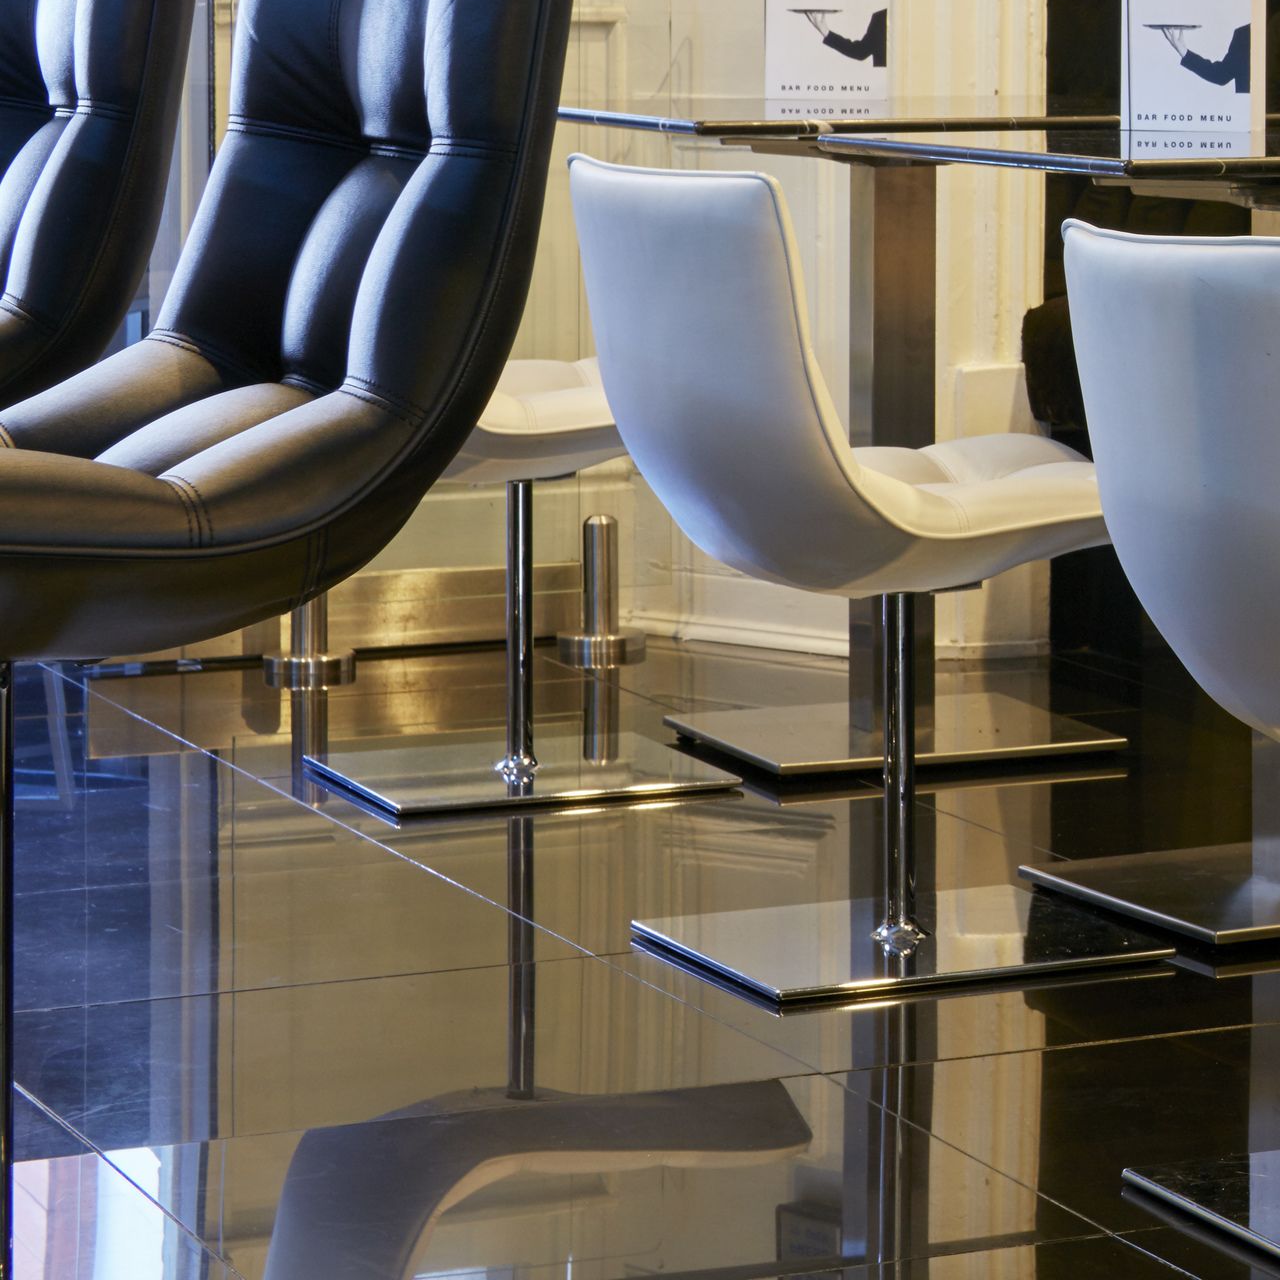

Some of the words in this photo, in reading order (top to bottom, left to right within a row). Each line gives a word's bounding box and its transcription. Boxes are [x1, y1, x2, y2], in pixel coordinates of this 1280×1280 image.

[780, 84, 801, 92] BAR
[806, 84, 835, 92] FOOD
[840, 84, 871, 92] MENU
[1136, 113, 1158, 122] BAR
[1163, 113, 1194, 122] FOOD
[1200, 114, 1233, 123] MENU
